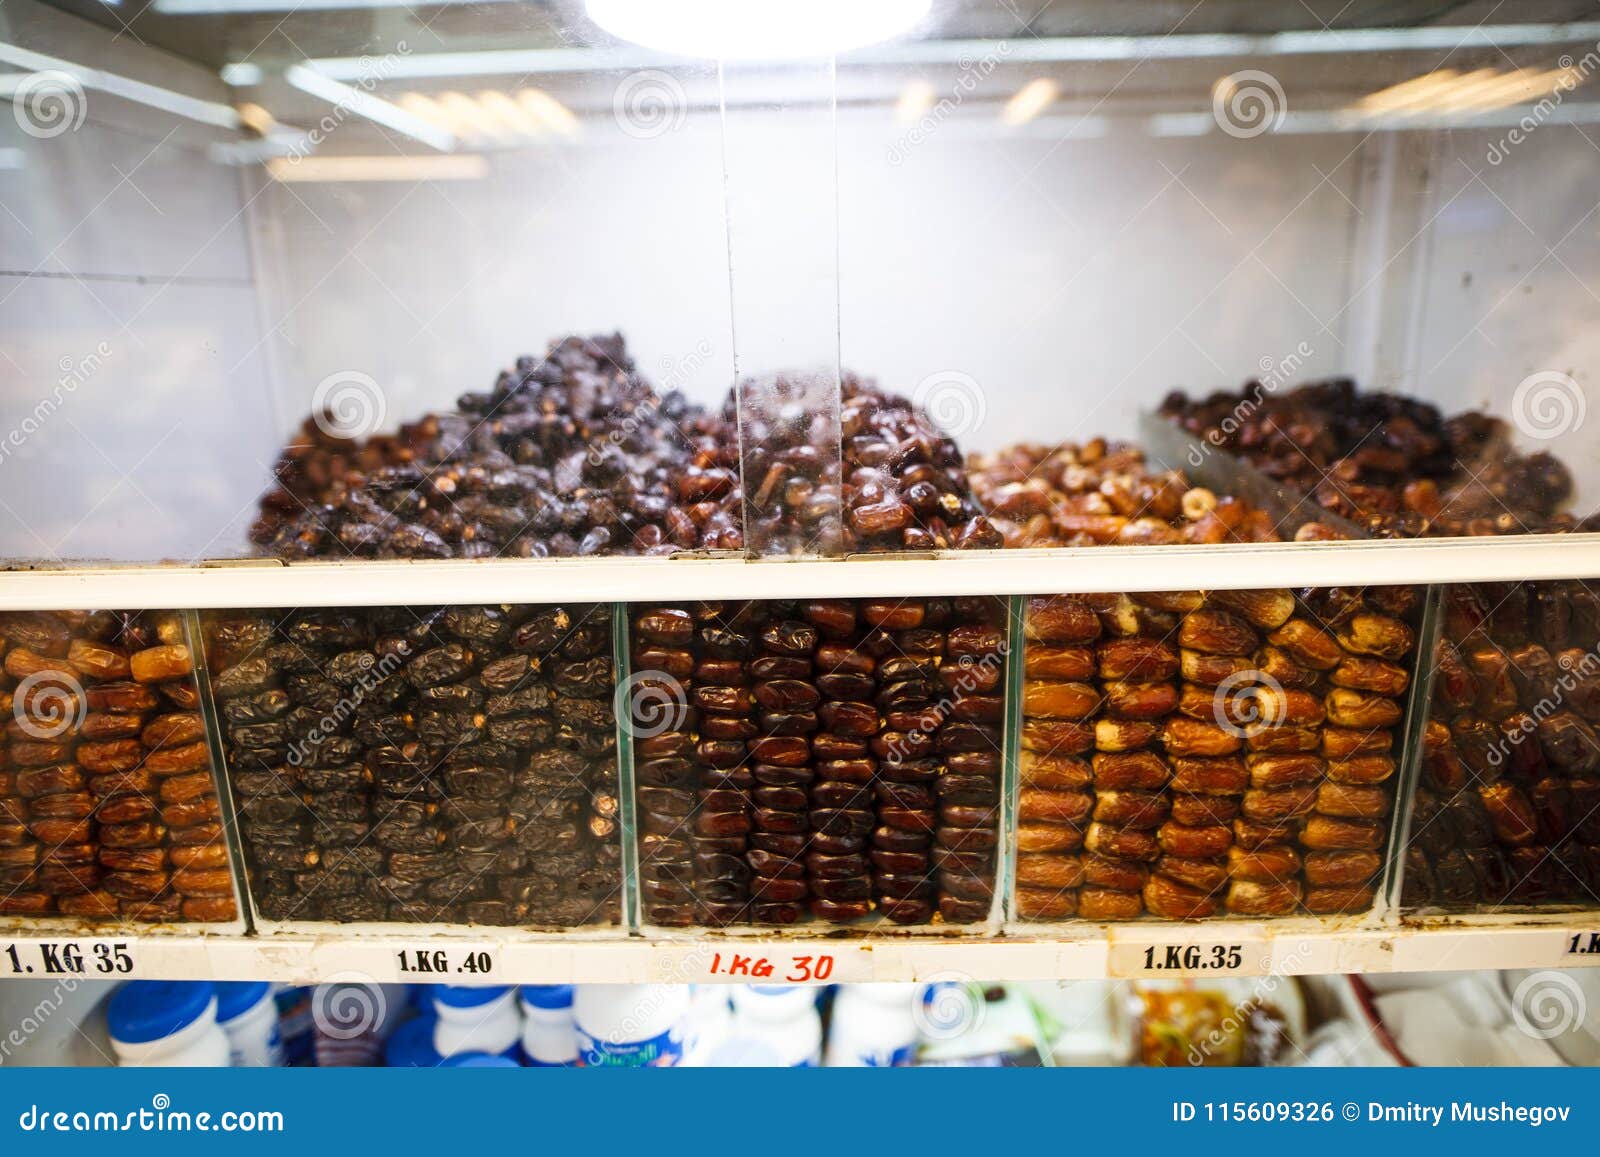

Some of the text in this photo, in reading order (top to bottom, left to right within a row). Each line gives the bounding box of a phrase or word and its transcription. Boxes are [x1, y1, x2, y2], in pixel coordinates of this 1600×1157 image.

[5, 943, 134, 973] 1. KG 35
[397, 950, 493, 973] 1.KG .40
[786, 955, 834, 982] 30
[1144, 945, 1242, 969] 1.KG.35
